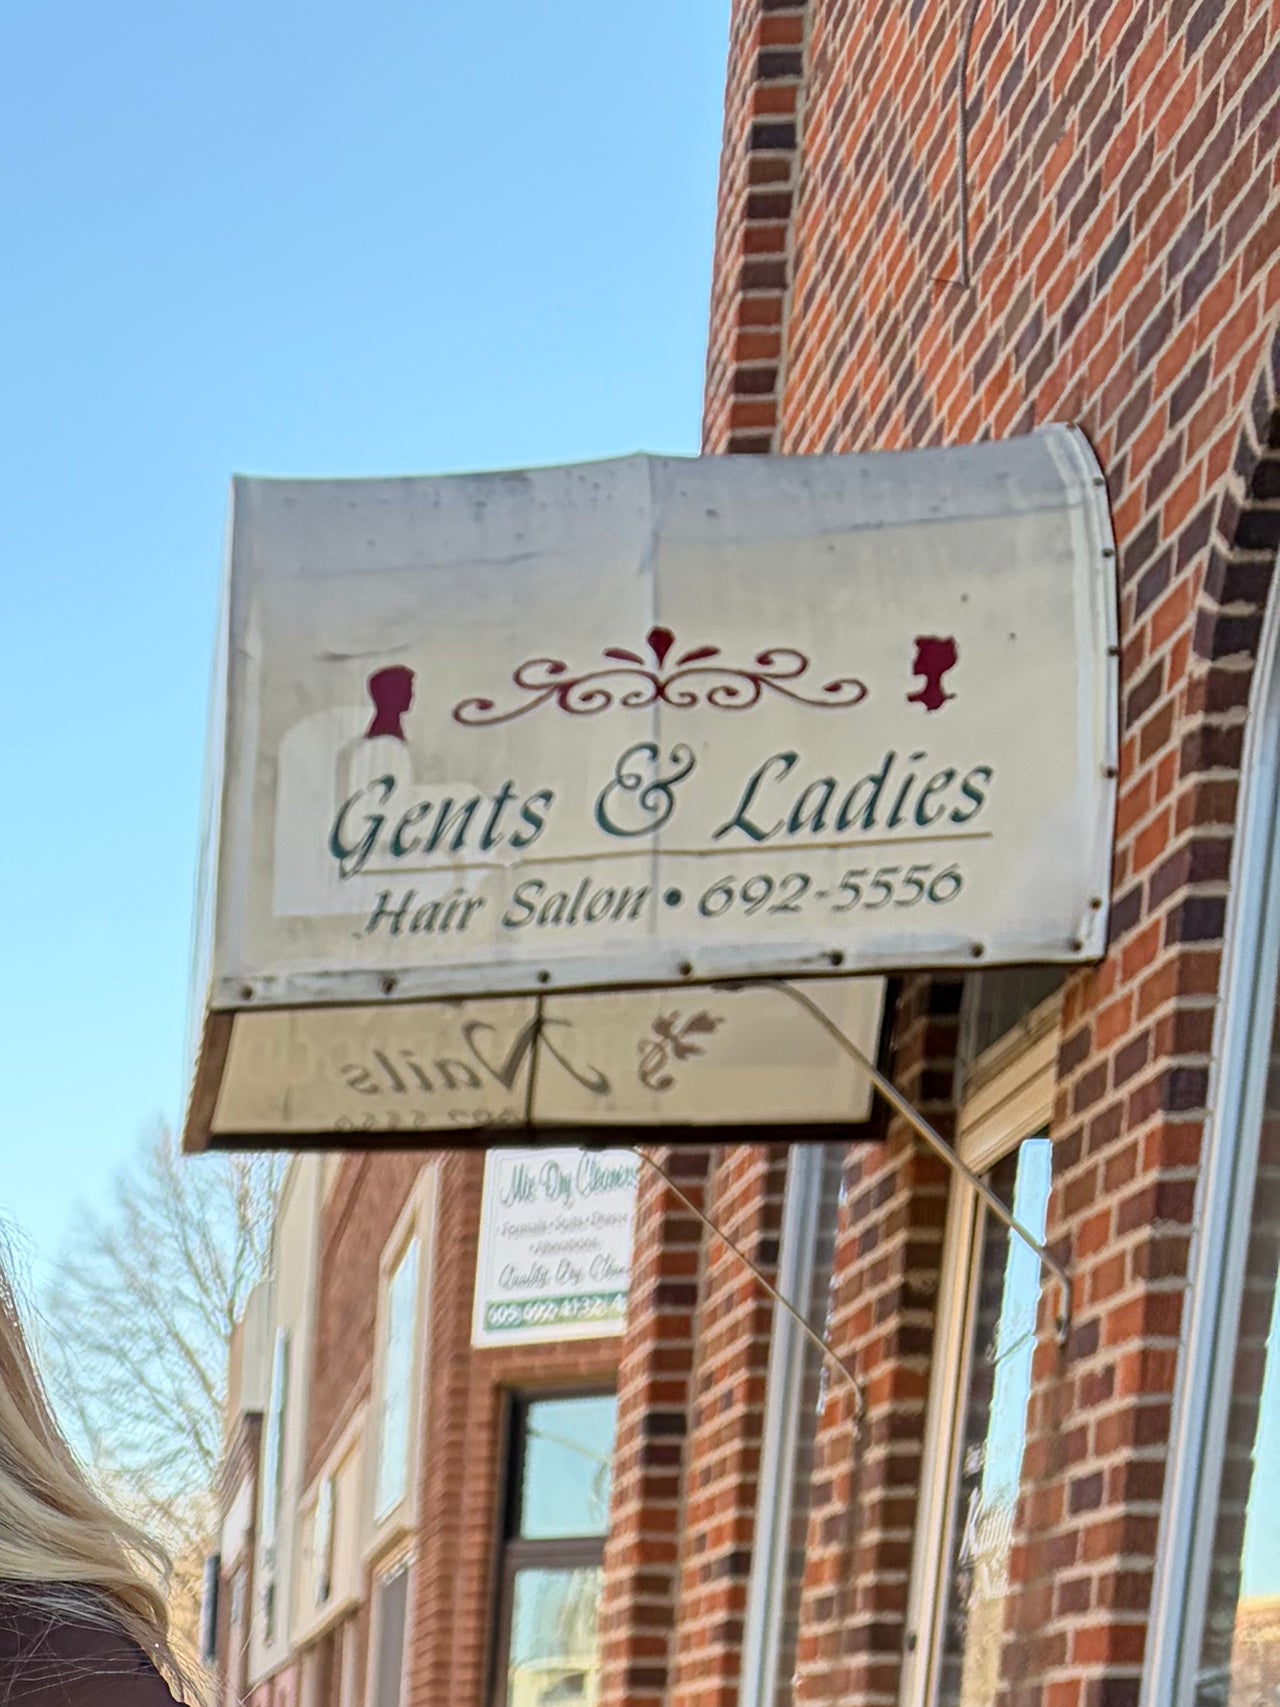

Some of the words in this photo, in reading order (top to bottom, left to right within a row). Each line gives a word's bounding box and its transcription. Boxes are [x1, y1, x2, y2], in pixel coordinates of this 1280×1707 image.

[329, 773, 555, 880] Gents
[595, 741, 695, 838] &
[711, 750, 993, 841] Ladies
[363, 888, 486, 937] Hair
[502, 876, 652, 929] Salon
[698, 863, 962, 918] 692-5556
[540, 1160, 574, 1209] Dry
